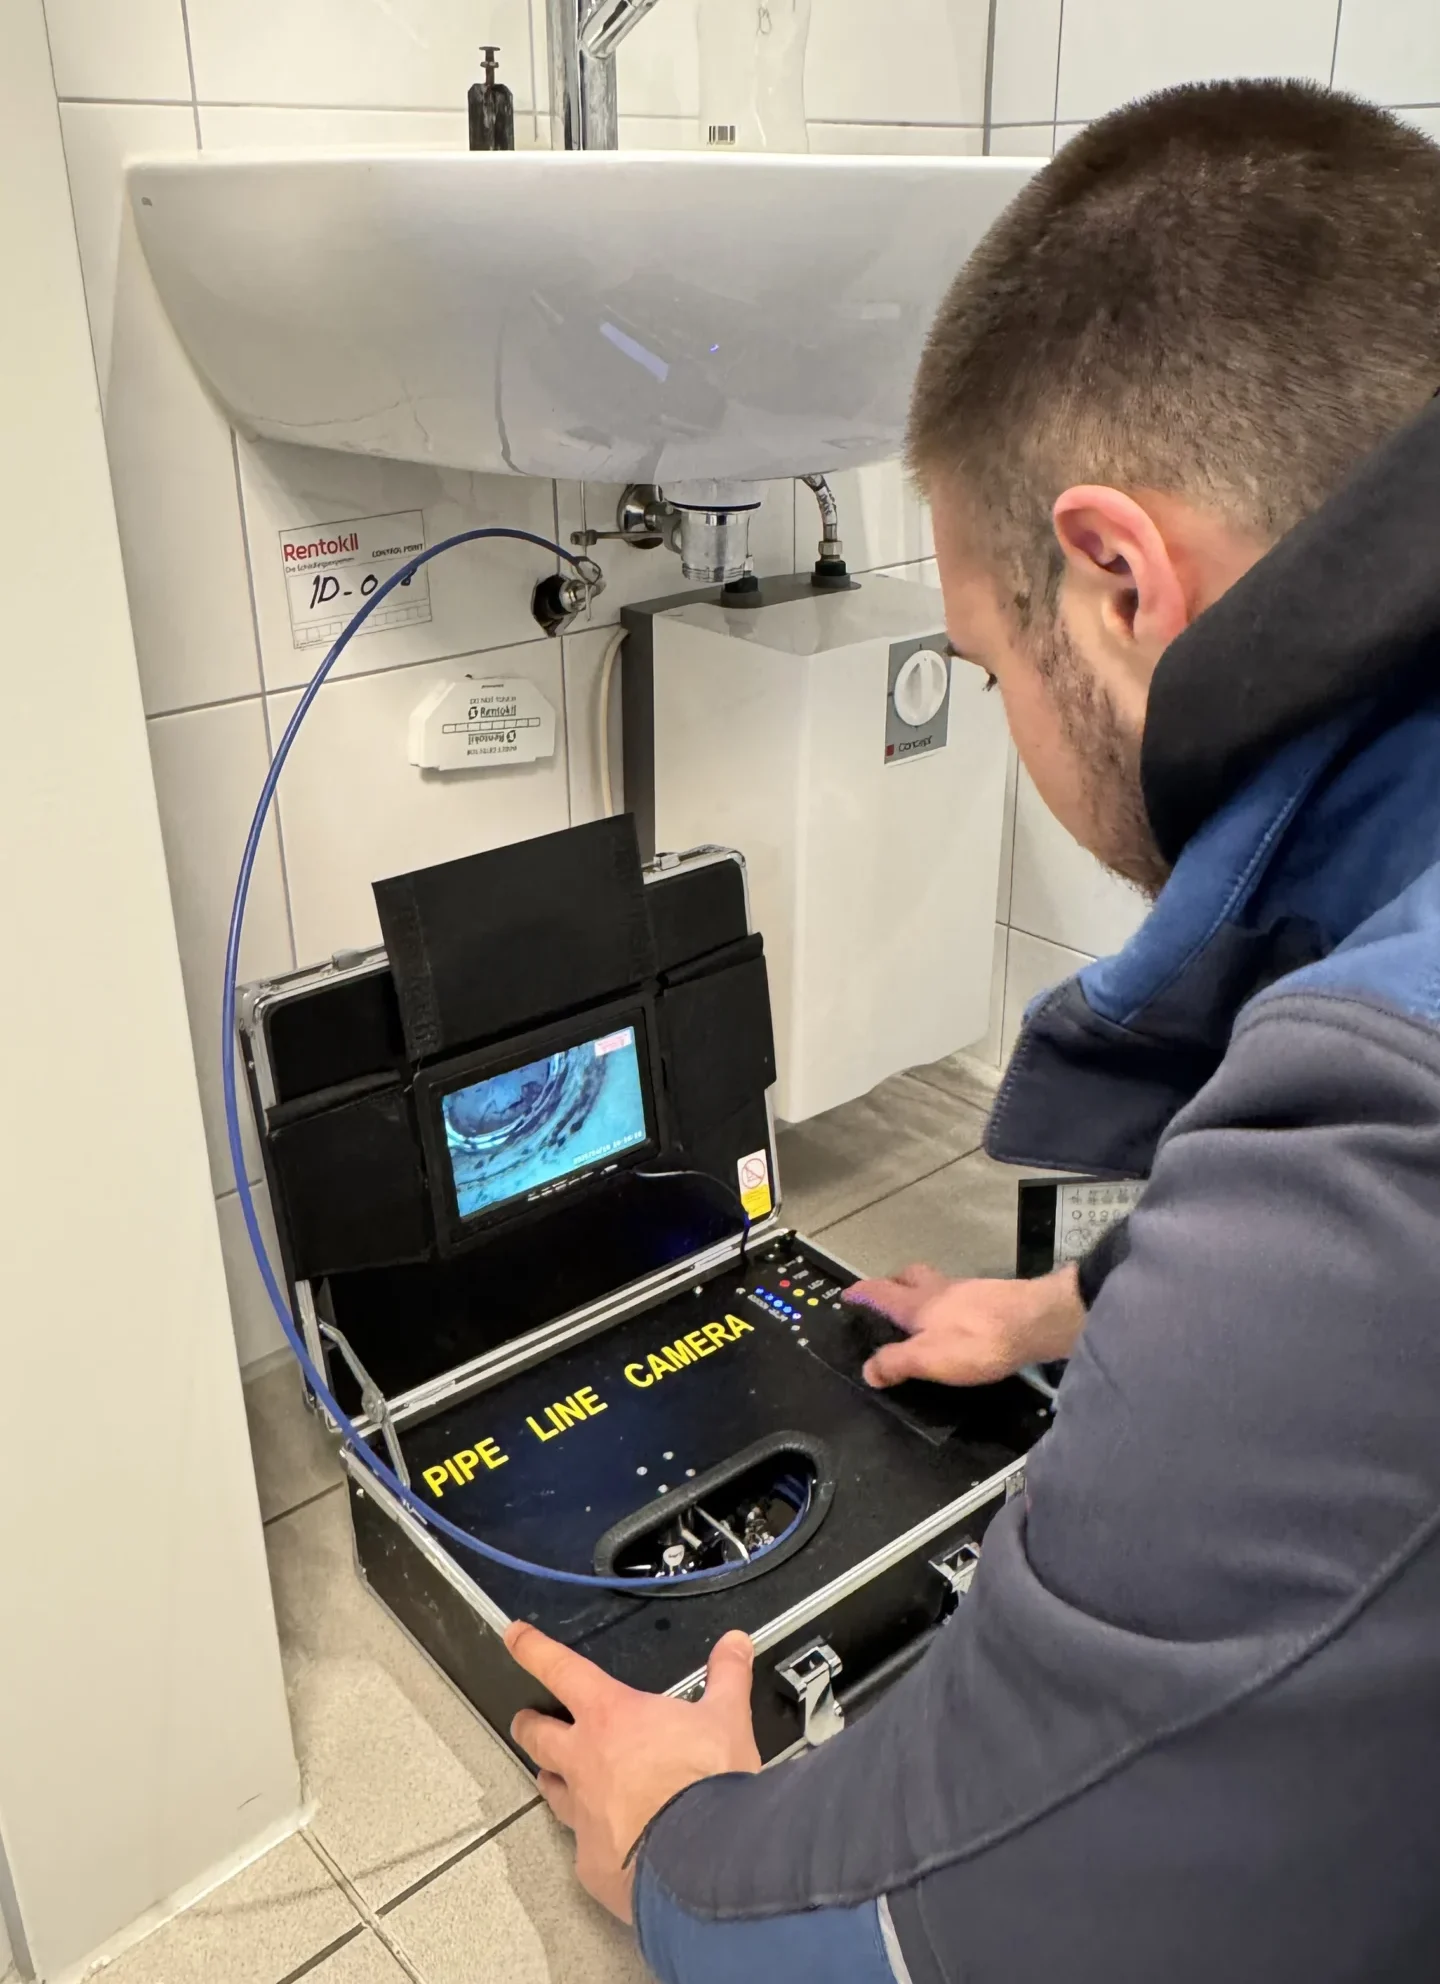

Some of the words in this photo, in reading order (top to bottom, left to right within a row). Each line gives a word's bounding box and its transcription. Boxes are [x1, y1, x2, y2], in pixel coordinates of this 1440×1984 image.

[283, 532, 359, 562] Rentokil
[480, 704, 517, 718] Rentokil
[422, 1437, 510, 1498] PIPE
[525, 1386, 609, 1443] LINE
[623, 1313, 756, 1389] CAMERA
